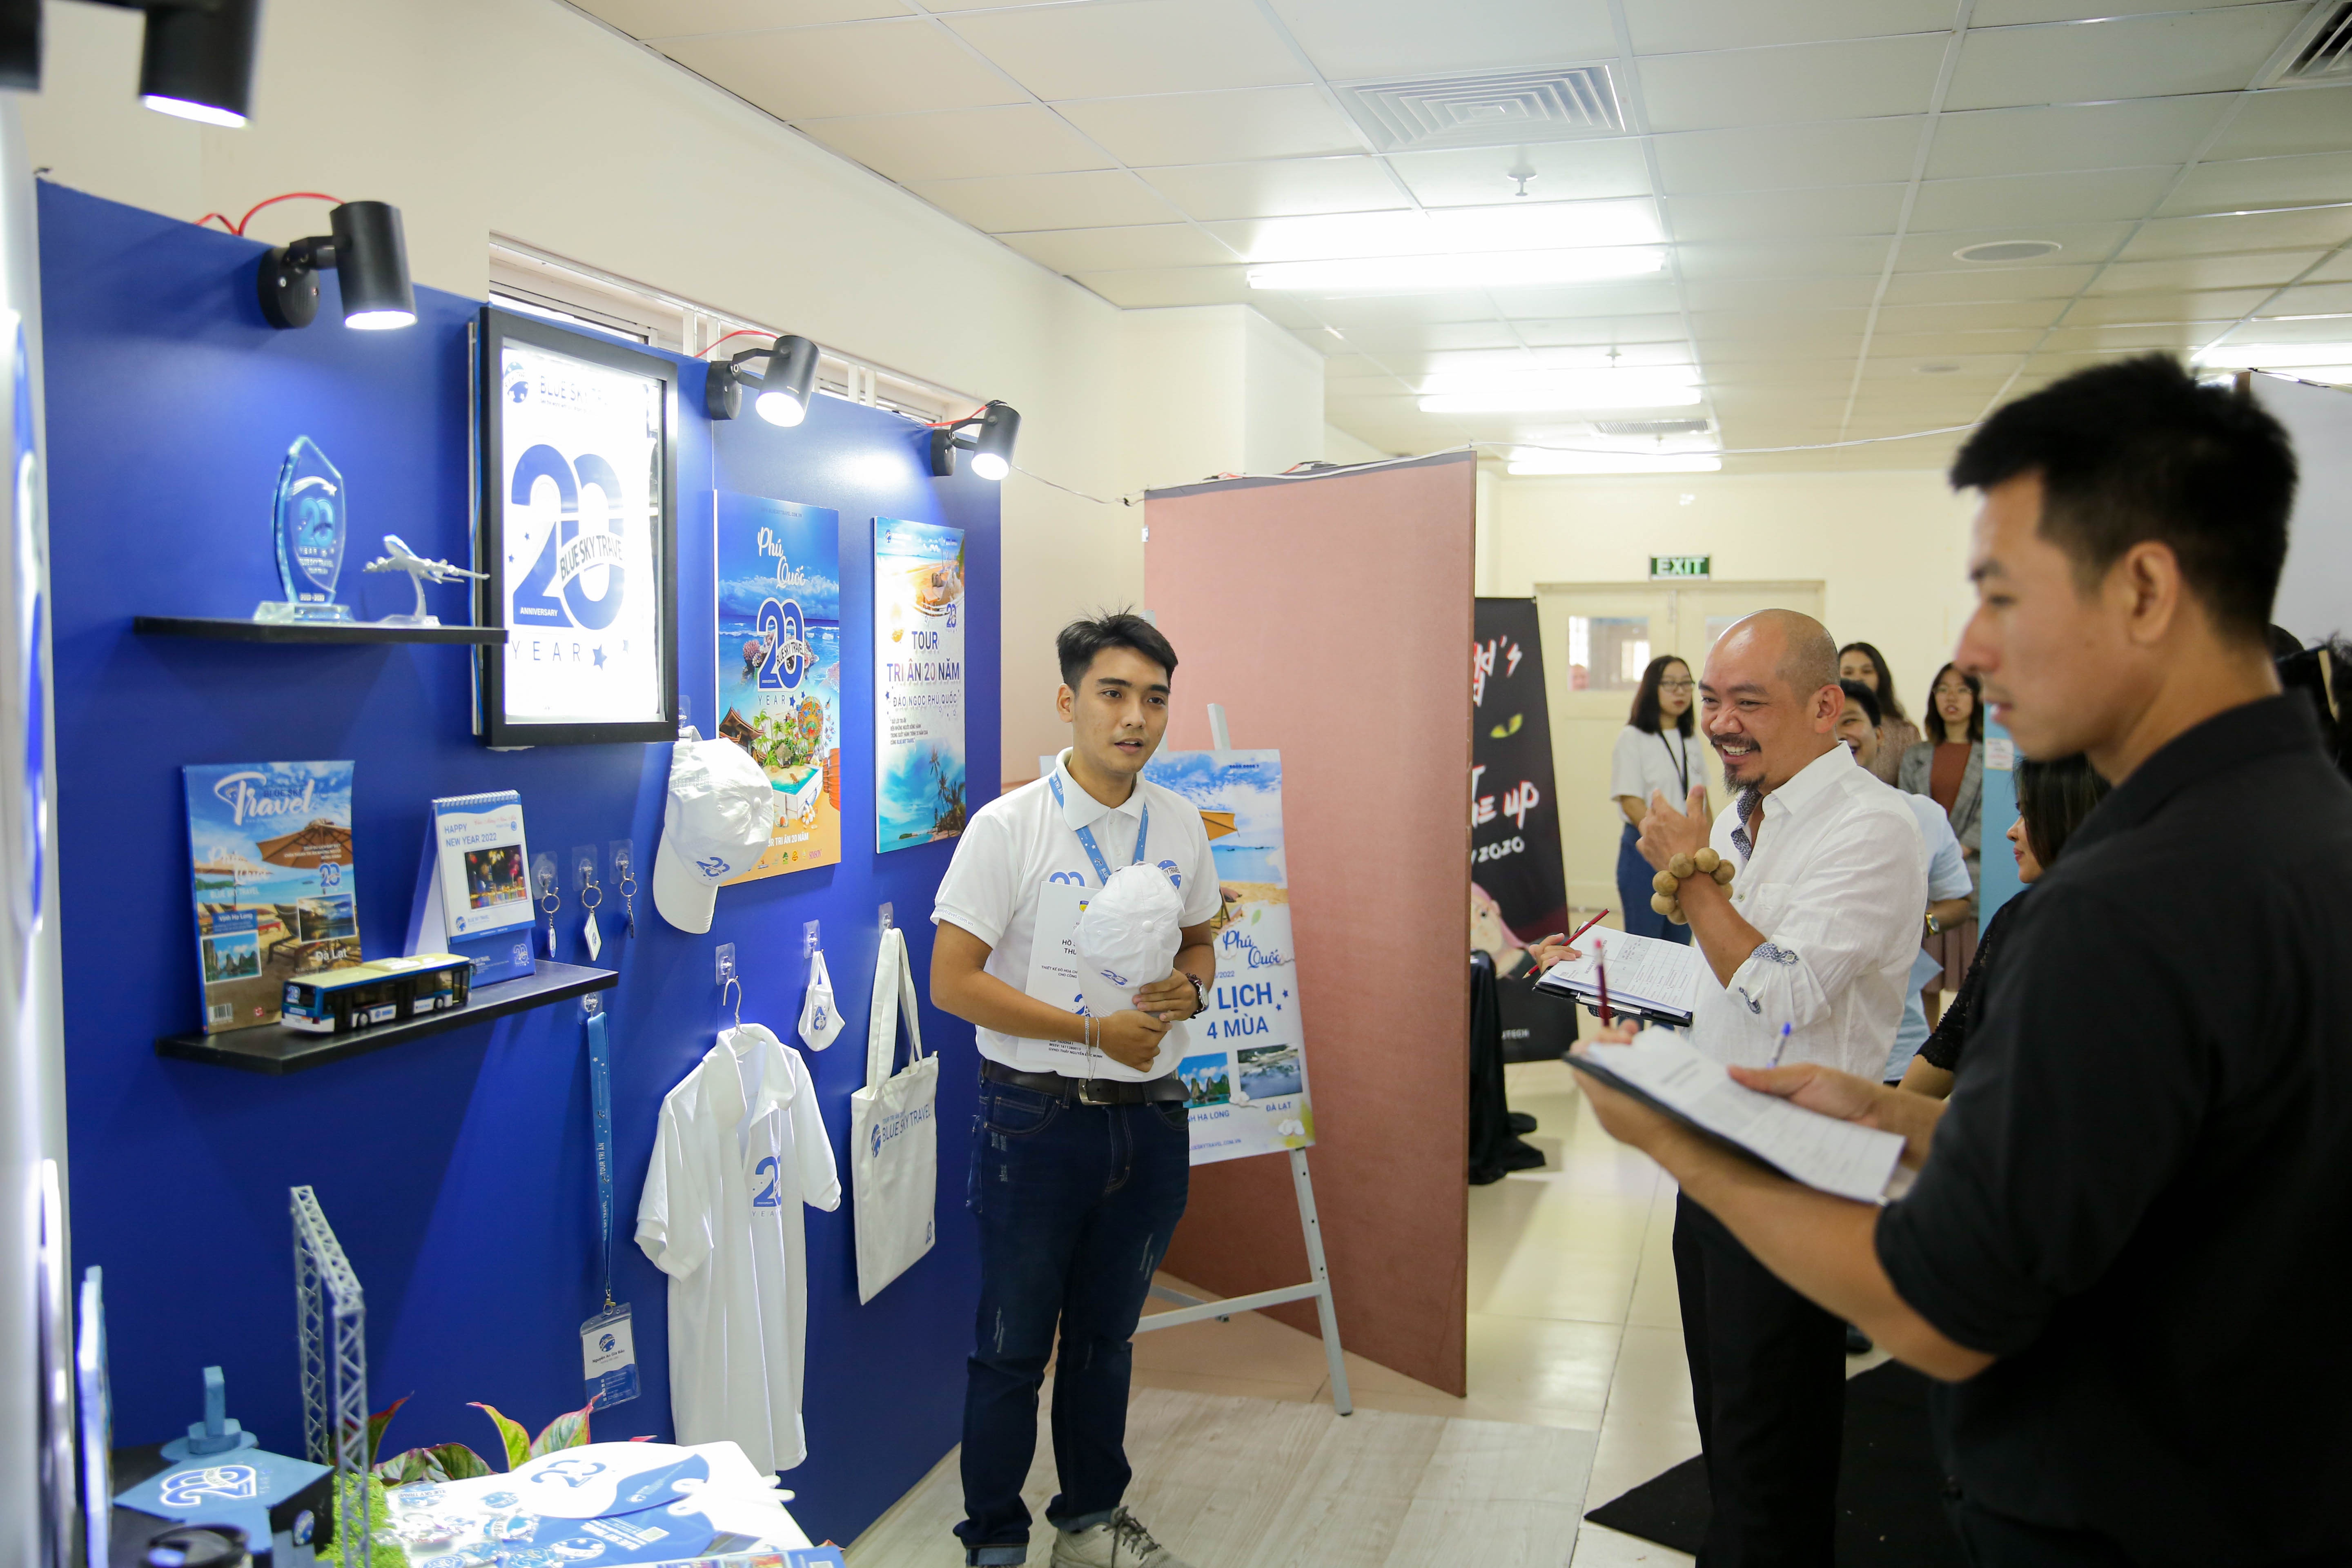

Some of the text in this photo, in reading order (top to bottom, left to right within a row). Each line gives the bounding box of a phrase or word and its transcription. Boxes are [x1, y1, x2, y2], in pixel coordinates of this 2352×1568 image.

[299, 497, 336, 547] 20
[511, 443, 624, 630] 20
[757, 526, 784, 557] Phú
[560, 535, 623, 581] BLUE SKY TRAVE
[1657, 558, 1705, 575] EXIT
[776, 556, 808, 589] Quốc
[520, 607, 558, 617] ANNIVERSARY
[947, 604, 957, 628] 20
[511, 640, 580, 662] YEAR
[758, 598, 804, 690] 20
[791, 641, 804, 655] TRAVEL
[911, 631, 938, 650] TOUR
[887, 658, 959, 682] TRI ÂN 20 NĂM
[758, 695, 786, 706] YEAR
[909, 695, 926, 708] NGỌC
[928, 693, 939, 705] PHÚ
[941, 690, 957, 704] QUỐC
[214, 771, 315, 826] Travel
[287, 788, 303, 797] SKY
[444, 823, 467, 834] HAPPY
[784, 834, 791, 844] ÂN
[791, 834, 797, 843] 20
[798, 832, 809, 841] NĂM
[446, 833, 497, 847] NEW YEAR 2022
[319, 862, 341, 888] 20
[1223, 930, 1254, 951] Phú
[316, 948, 347, 961] Đà Lạt
[1247, 947, 1282, 969] Quốc
[1214, 970, 1235, 978] /2022
[1217, 982, 1273, 1013] LỊCH
[1207, 1013, 1269, 1039] 4 MÙA
[1198, 1113, 1208, 1122] HẠ
[1210, 1110, 1229, 1119] LONG
[1266, 1101, 1292, 1111] ĐÀ LẠT
[882, 1122, 899, 1143] BLUE
[900, 1117, 909, 1134] SKY
[909, 1104, 931, 1126] TRAVEL
[596, 1142, 605, 1150] ÂN
